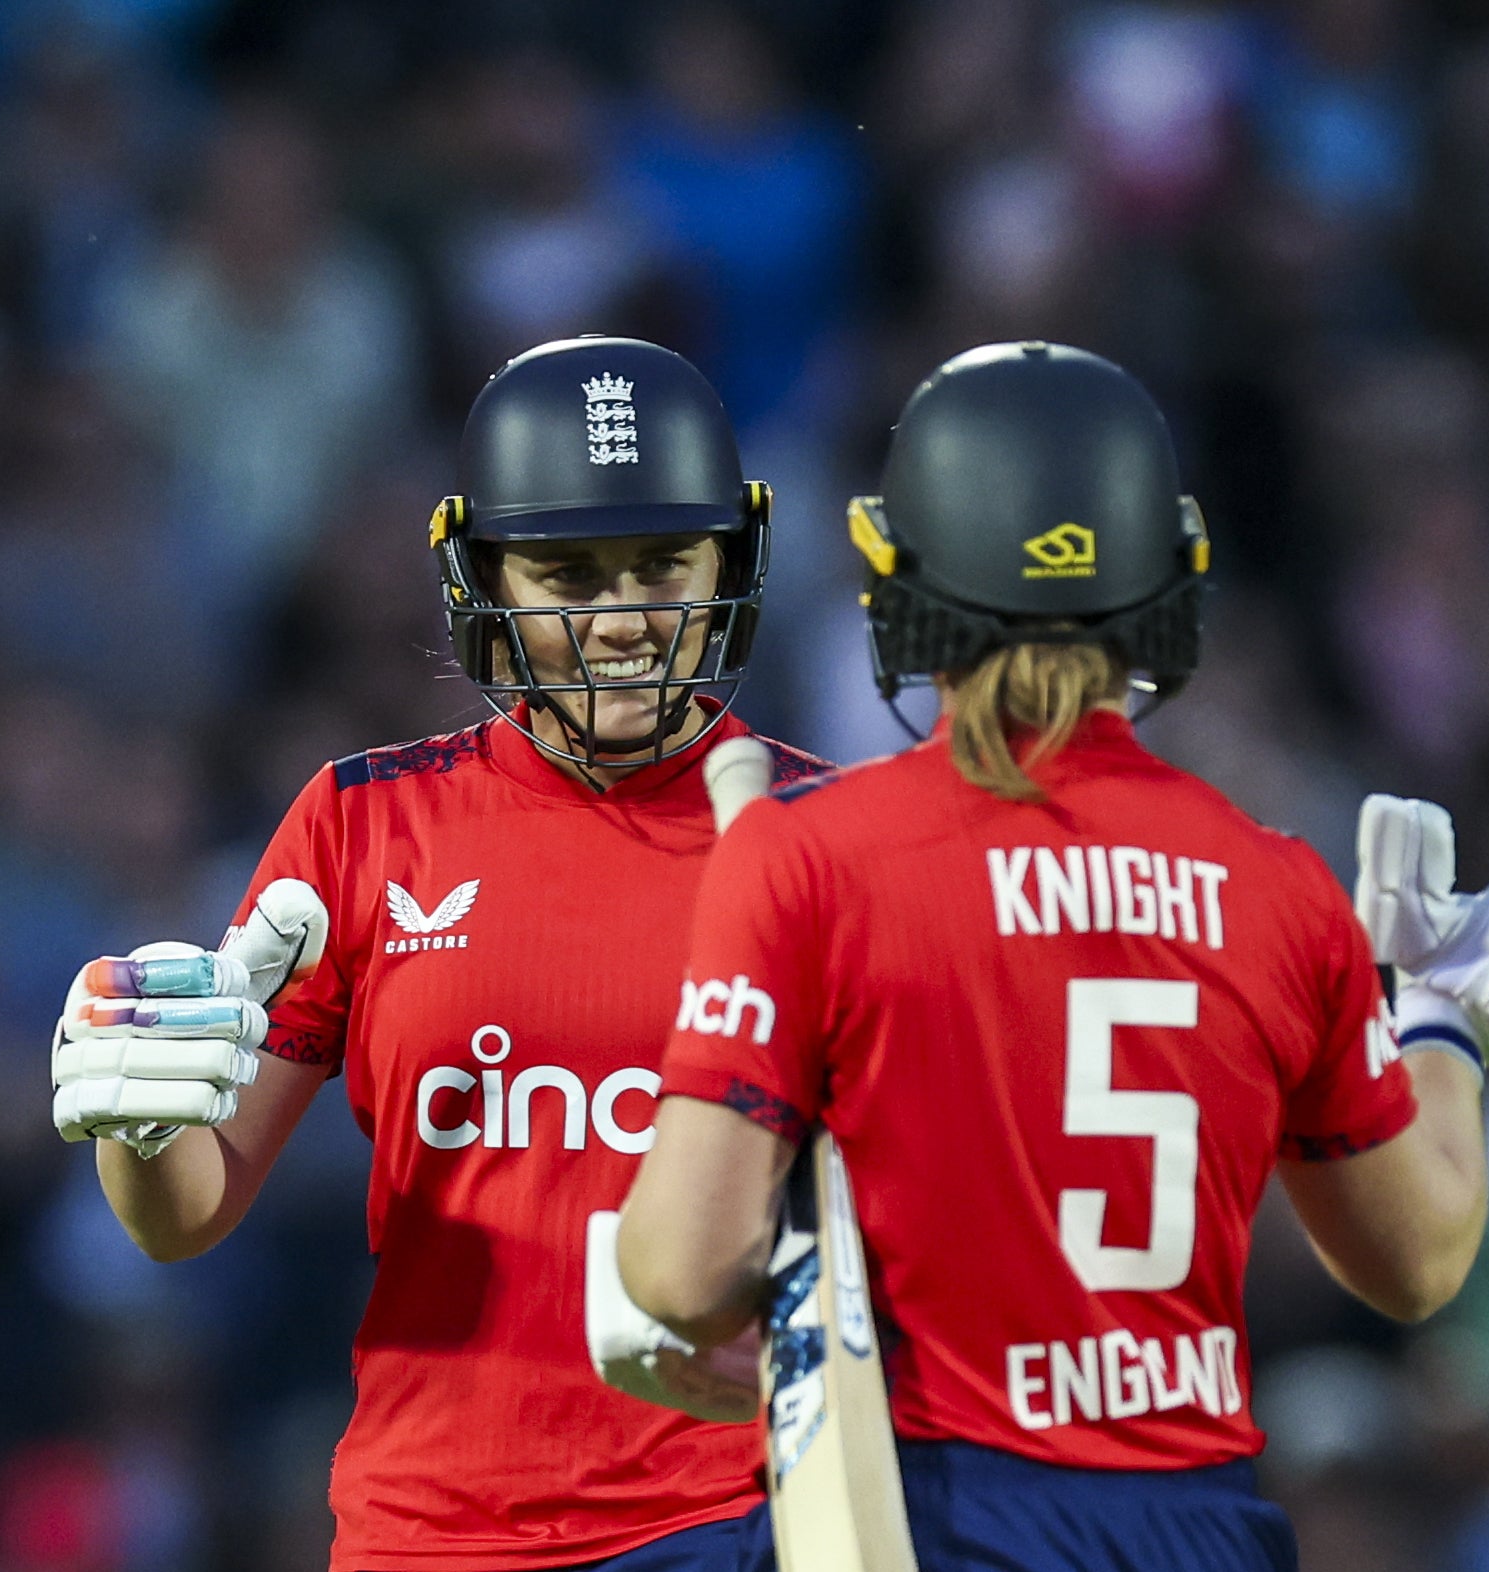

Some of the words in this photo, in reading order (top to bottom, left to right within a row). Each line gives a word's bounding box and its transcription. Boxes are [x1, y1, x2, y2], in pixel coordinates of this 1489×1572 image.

[384, 934, 469, 954] CASTORE
[986, 845, 1229, 950] KNIGHT
[1058, 977, 1201, 1292] 5
[1005, 1325, 1243, 1430] ENGLND
